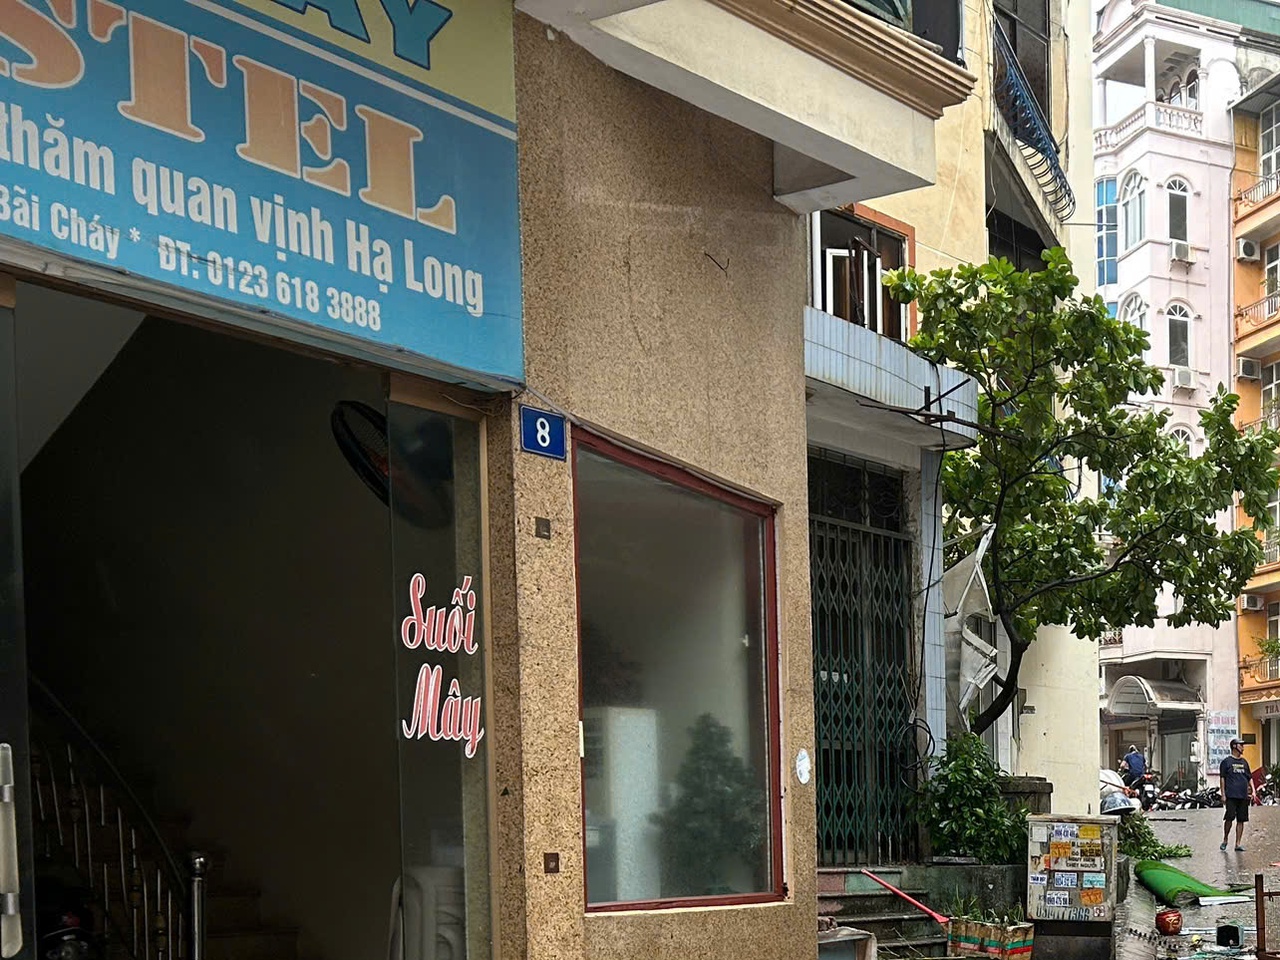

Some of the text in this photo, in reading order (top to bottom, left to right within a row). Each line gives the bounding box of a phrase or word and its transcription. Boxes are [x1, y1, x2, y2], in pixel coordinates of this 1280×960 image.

[50, 202, 120, 259] Cháy
[207, 249, 269, 299] 0123
[275, 275, 320, 314] 618
[326, 287, 382, 331] 3888
[132, 156, 238, 234] quan
[250, 193, 334, 262] vịnh
[346, 217, 394, 294] Hạ
[404, 238, 484, 318] Long
[535, 417, 550, 447] 8
[401, 572, 479, 655] Suối
[402, 663, 484, 759] Mây
